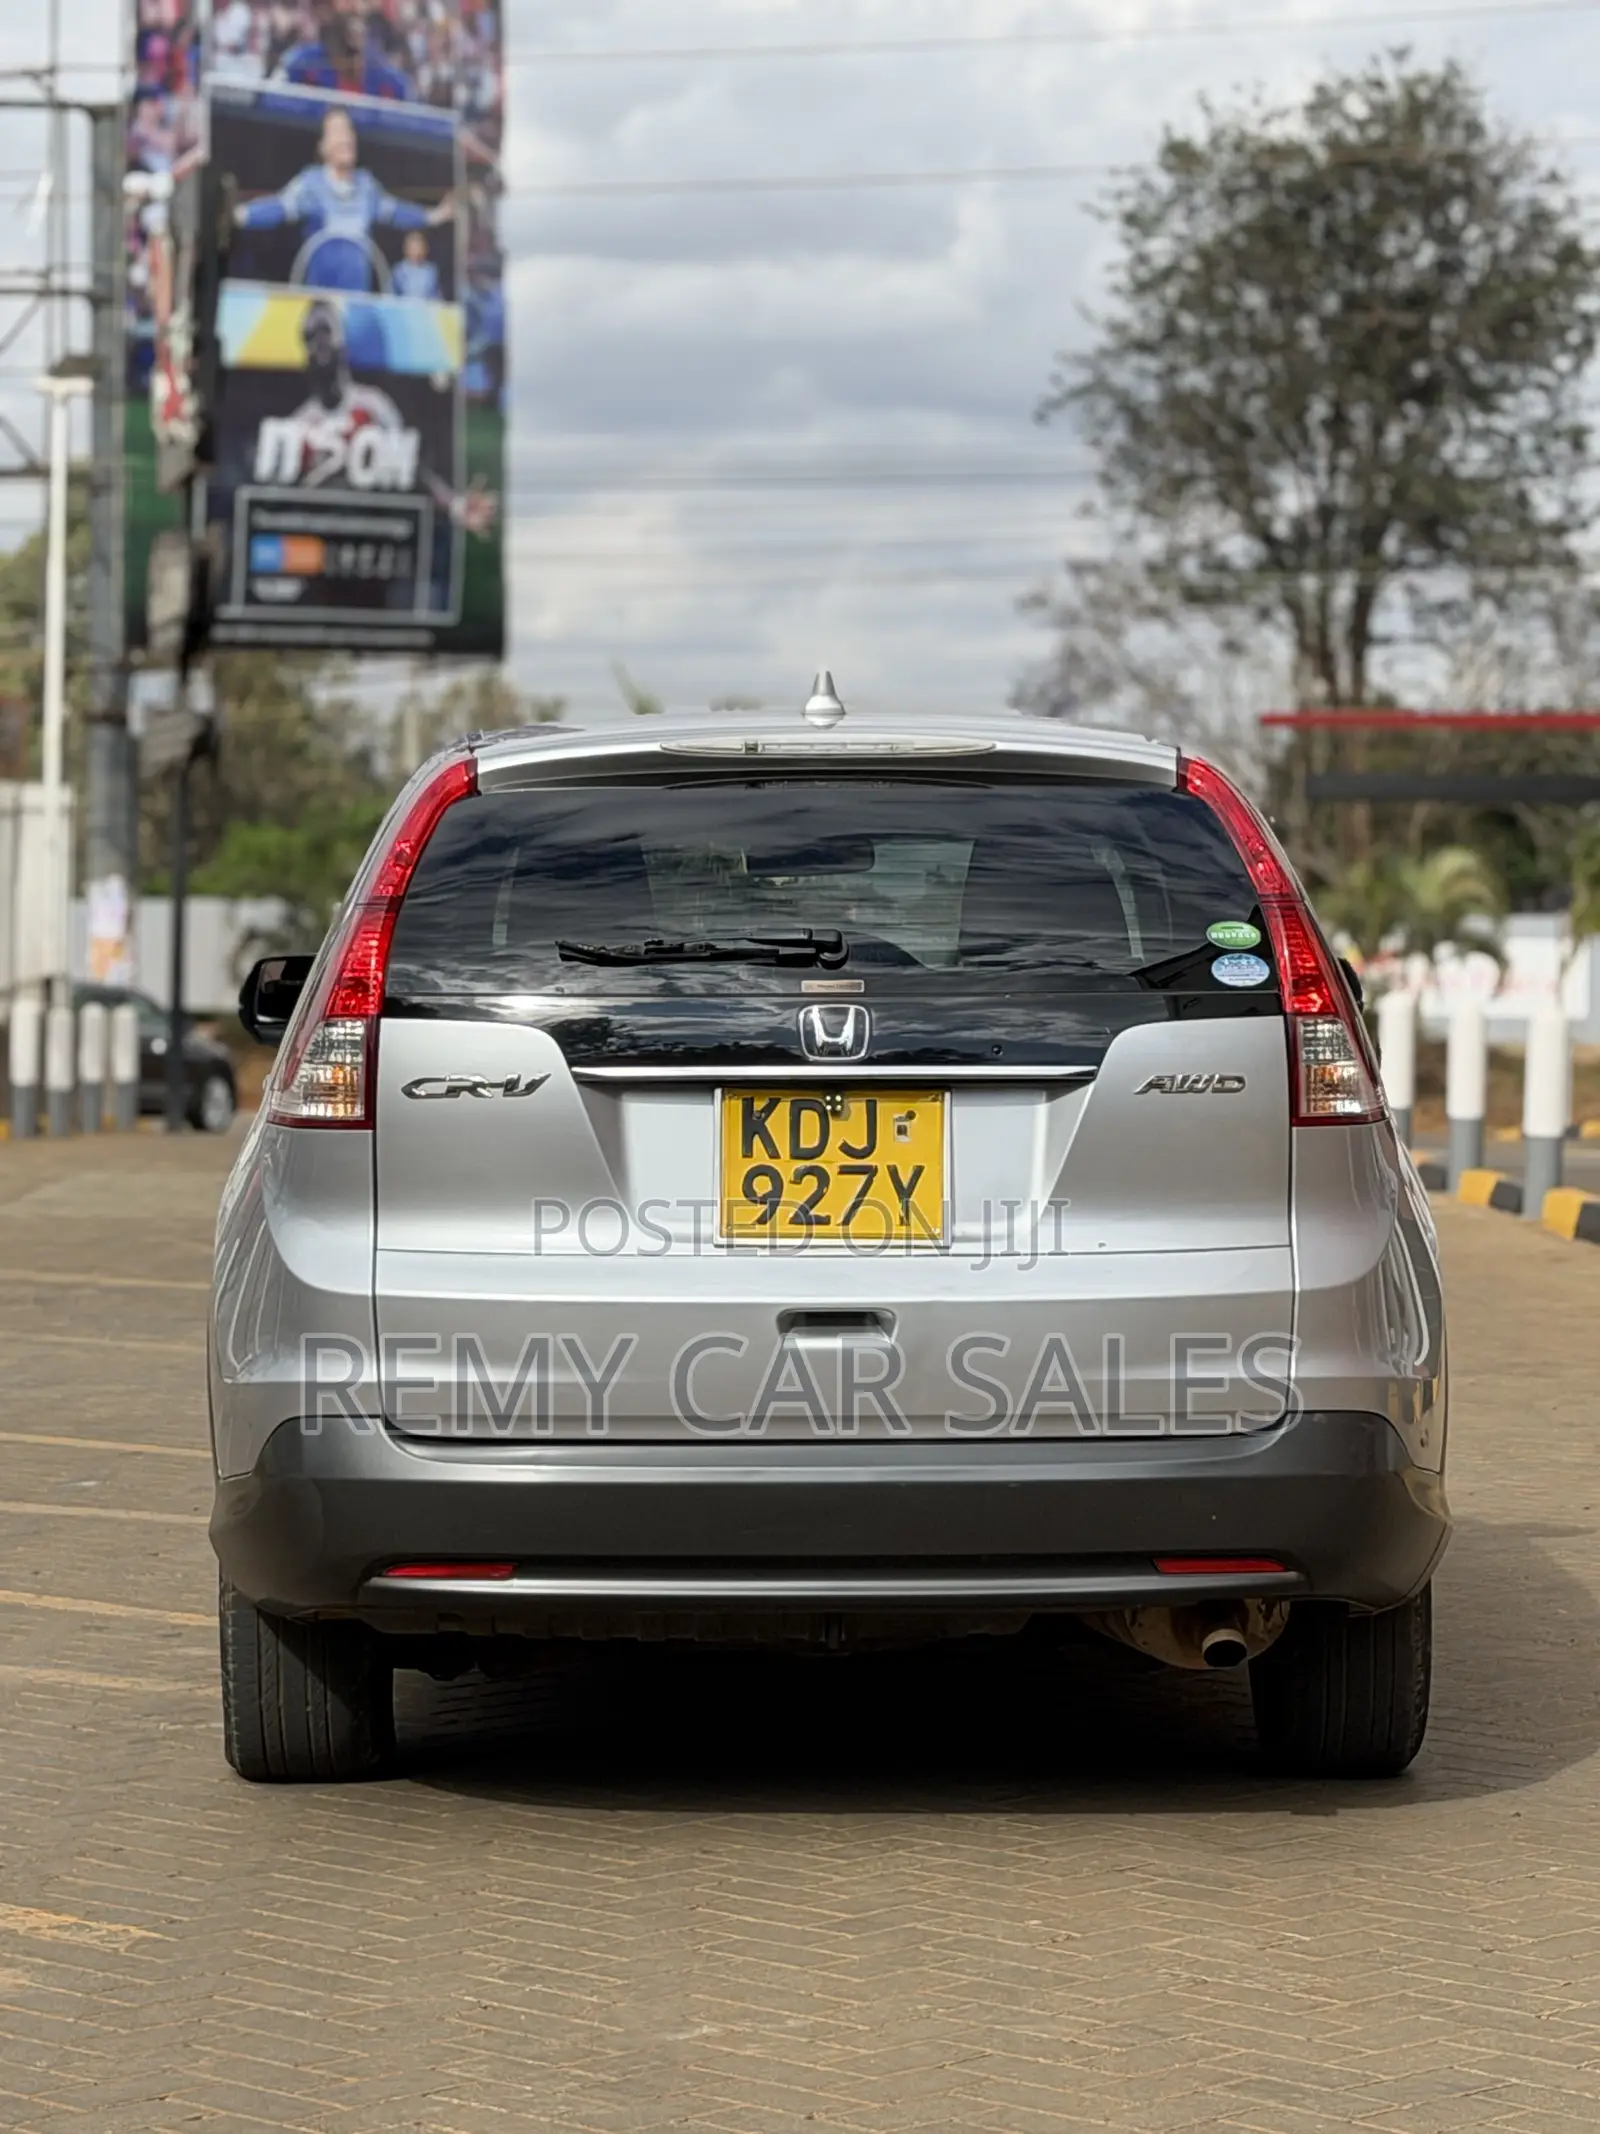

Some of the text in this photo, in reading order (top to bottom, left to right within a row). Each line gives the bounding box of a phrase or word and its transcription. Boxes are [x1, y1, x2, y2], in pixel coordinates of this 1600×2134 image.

[401, 1073, 552, 1099] CR-V
[1133, 1073, 1246, 1095] AWD
[741, 1096, 877, 1160] KDJ
[742, 1164, 925, 1226] 927Y
